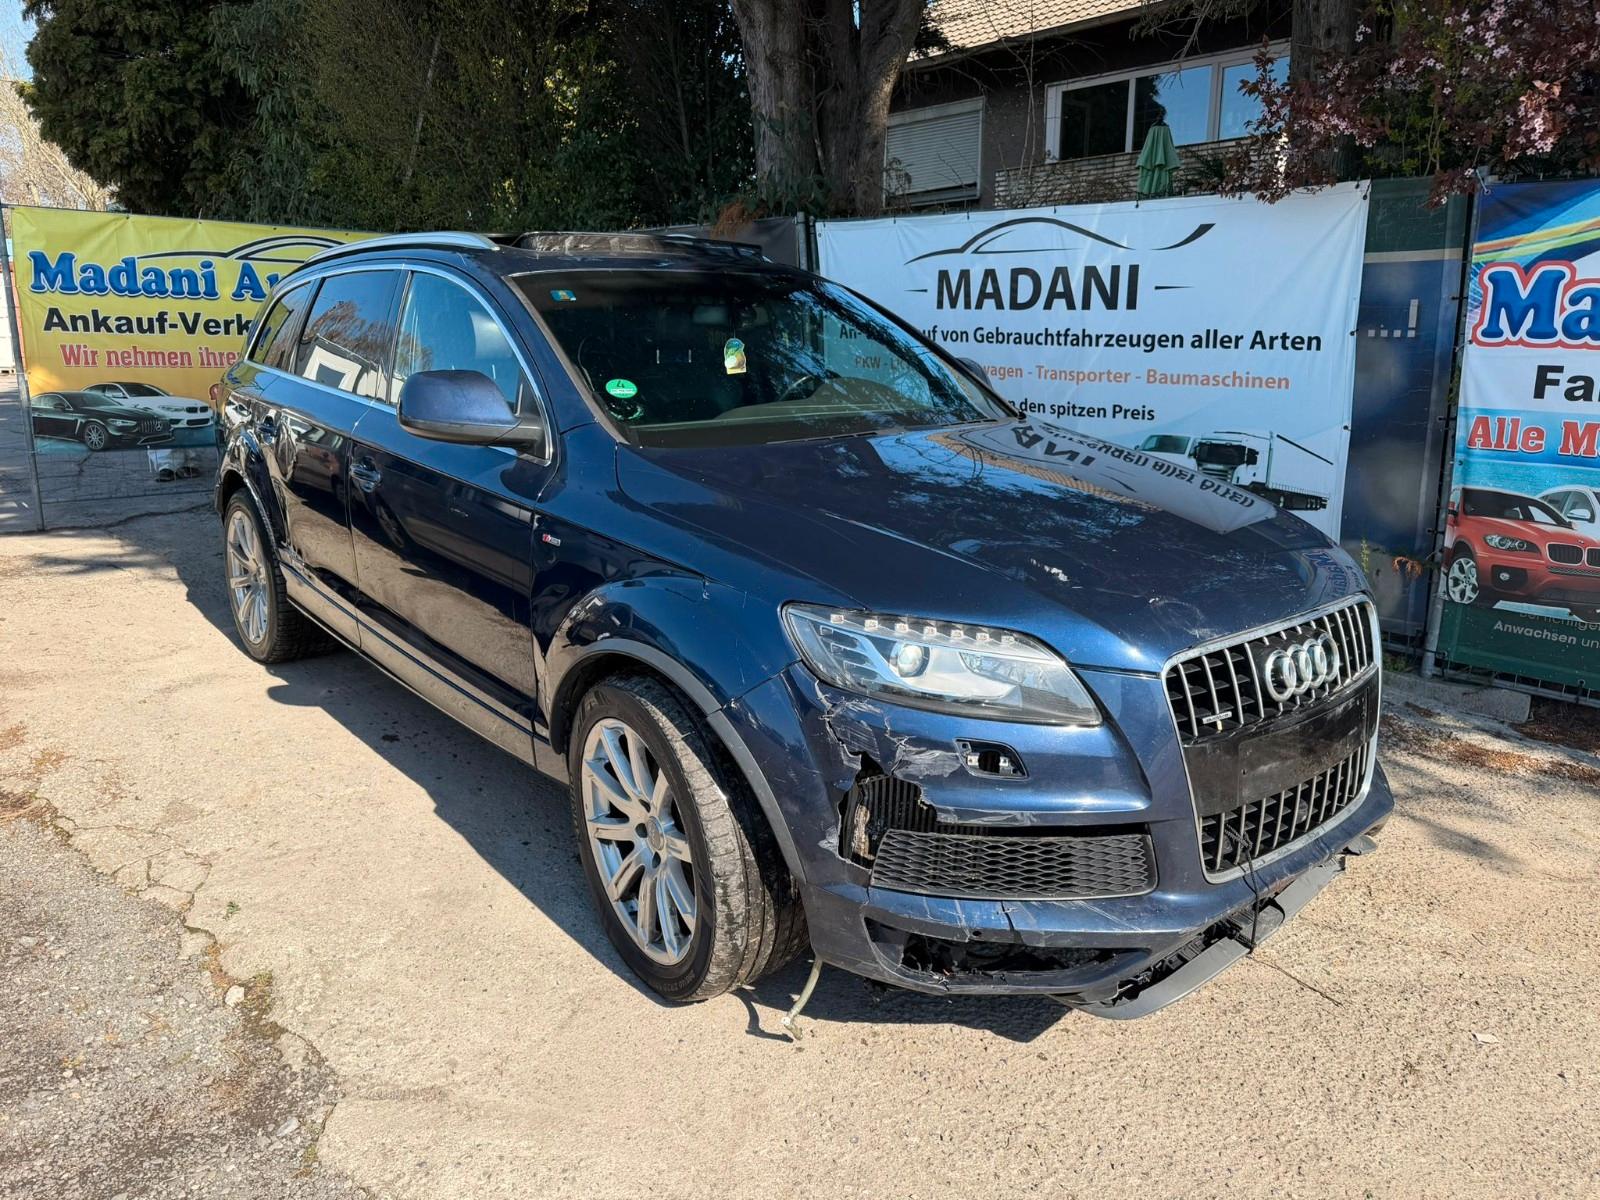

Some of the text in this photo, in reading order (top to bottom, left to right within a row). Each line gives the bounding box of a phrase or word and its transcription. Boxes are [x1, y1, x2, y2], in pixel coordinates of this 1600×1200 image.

[28, 250, 220, 300] Madani
[936, 264, 1140, 311] MADANI
[1476, 265, 1600, 346] Ma
[60, 344, 241, 368] Wir nehmen ihre
[941, 329, 969, 342] von
[973, 327, 1184, 353] Gebrauchtfahrzeugen
[1190, 329, 1244, 350] aller
[1249, 330, 1322, 351] Arten
[1036, 365, 1131, 385] Transporter
[1146, 368, 1290, 390] Baumaschinen
[1533, 365, 1600, 402] Fa
[1019, 398, 1045, 414] den
[1050, 401, 1106, 418] spitzen
[1112, 404, 1155, 421] Preis
[1467, 416, 1600, 458] Alle M
[1493, 620, 1577, 646] Anwachsen
[1581, 637, 1600, 650] un
